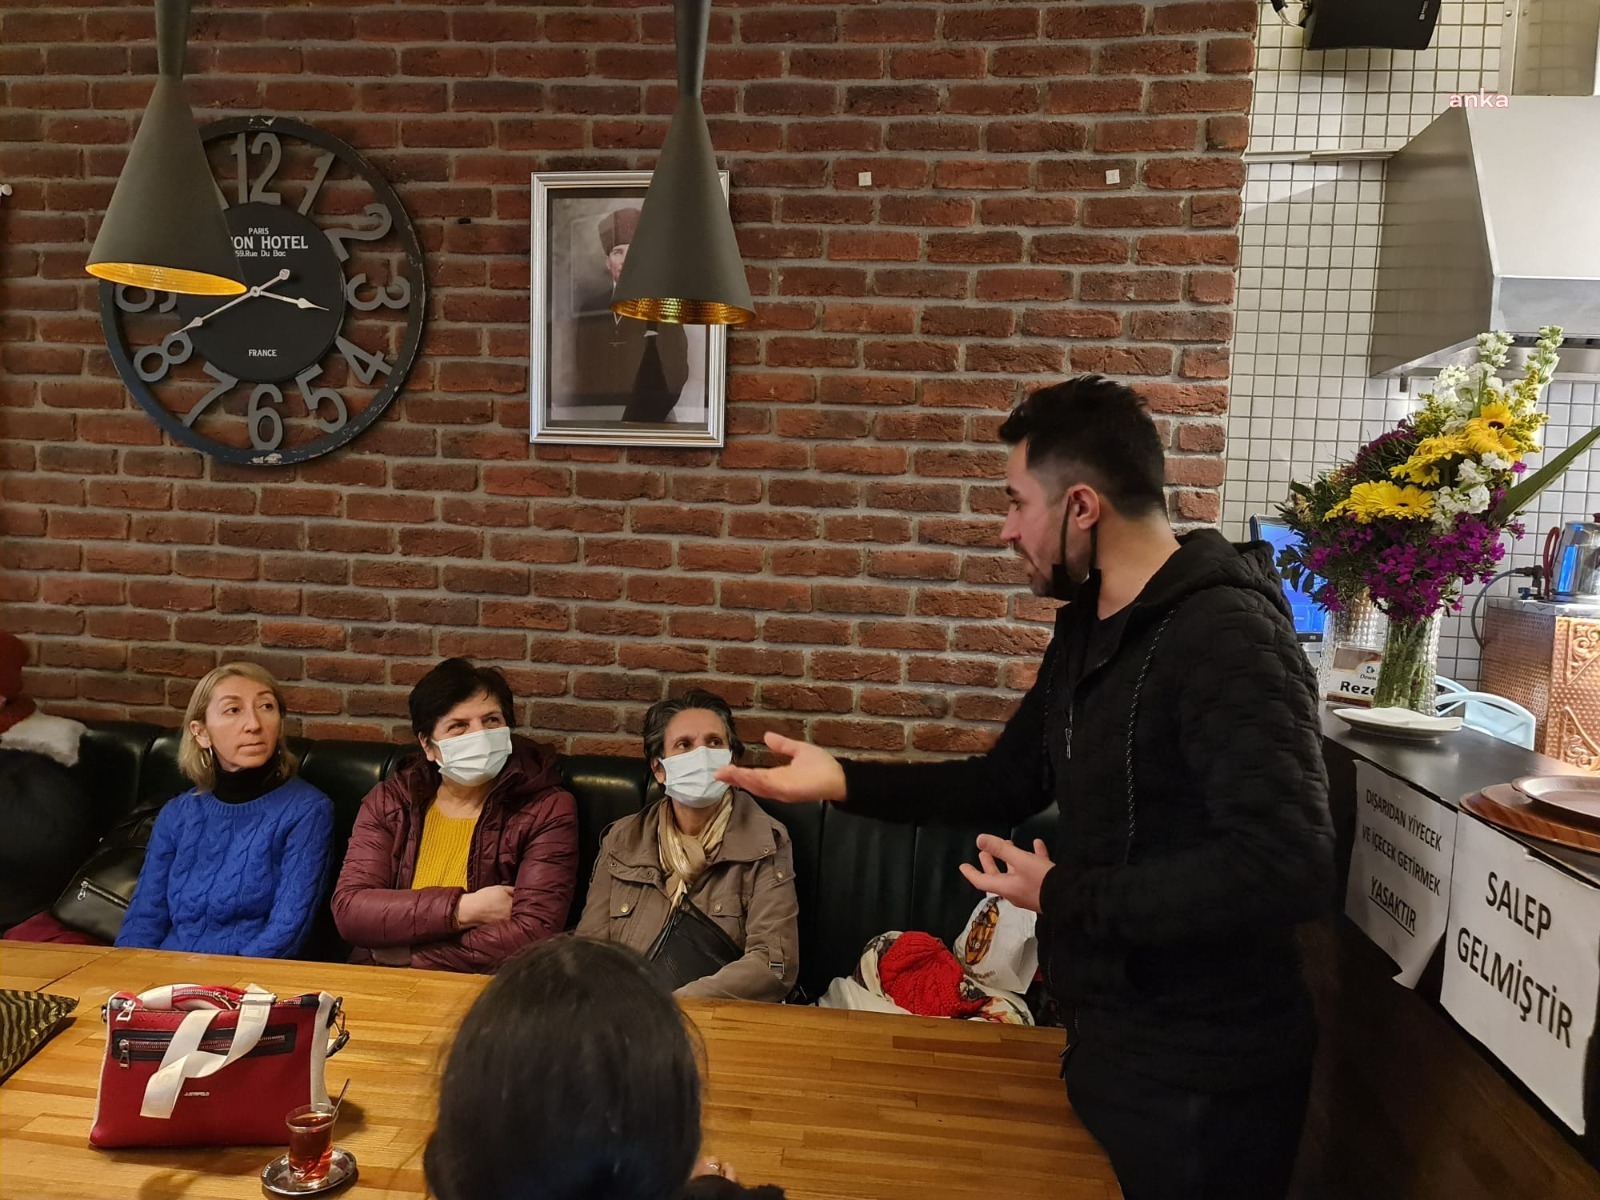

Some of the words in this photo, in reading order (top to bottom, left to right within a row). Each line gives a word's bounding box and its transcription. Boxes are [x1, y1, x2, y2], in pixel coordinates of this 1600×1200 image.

[231, 132, 281, 205] 12
[298, 153, 336, 215] 1
[231, 236, 254, 249] ON
[261, 235, 309, 249] HOTEL
[248, 227, 269, 235] PARIS
[323, 203, 393, 262] 2
[344, 273, 411, 311] 3
[133, 332, 193, 382] 8
[248, 349, 278, 357] FRANCE
[336, 335, 394, 385] 4
[182, 362, 238, 427] 7
[248, 383, 283, 450] 6
[295, 365, 348, 433] 5
[1366, 789, 1407, 829] DIŞARIDAN
[1408, 815, 1442, 852] YİYECEK
[1362, 823, 1371, 842] VE
[1372, 827, 1396, 862] İÇECEK
[1397, 851, 1441, 896] GETİRMEK
[1369, 875, 1417, 932] YASAKTIR
[1485, 871, 1552, 940] SALEP
[1456, 926, 1574, 1049] GELMİŞTİR
